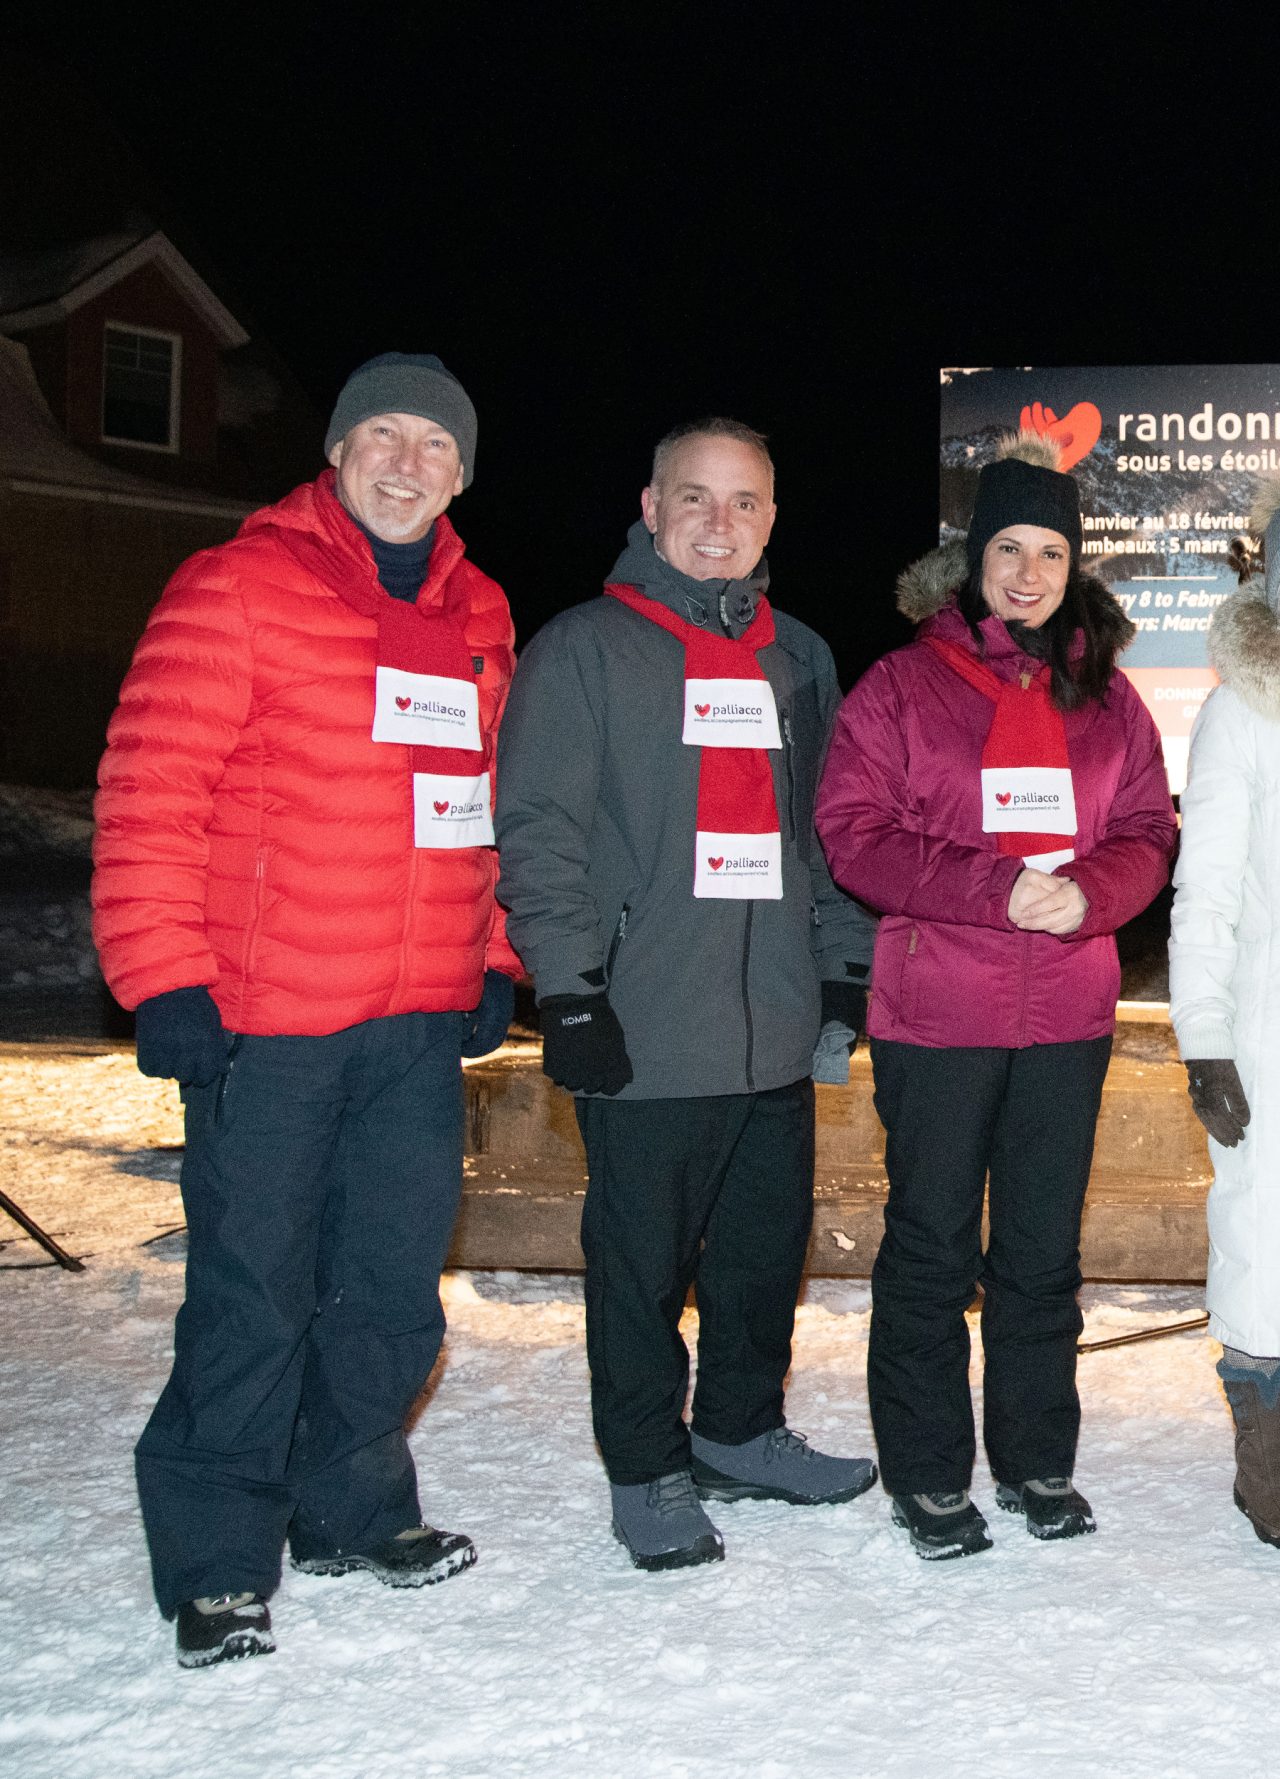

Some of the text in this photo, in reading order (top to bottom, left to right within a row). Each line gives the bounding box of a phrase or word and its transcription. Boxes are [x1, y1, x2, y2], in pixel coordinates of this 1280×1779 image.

[1117, 454, 1171, 472] sous
[1178, 450, 1213, 472] les
[1143, 516, 1164, 530] au
[1169, 513, 1190, 530] 18
[1194, 512, 1251, 530] février
[1169, 537, 1180, 554] 5
[1184, 541, 1228, 554] mars
[1139, 590, 1152, 608] 8
[1155, 592, 1173, 608] to
[413, 699, 466, 718] palliacco
[712, 703, 763, 718] palliacco
[1013, 792, 1059, 805] palliacco
[450, 802, 483, 816] palliacco
[725, 857, 769, 871] palliacco
[561, 1013, 592, 1026] KOMBI
